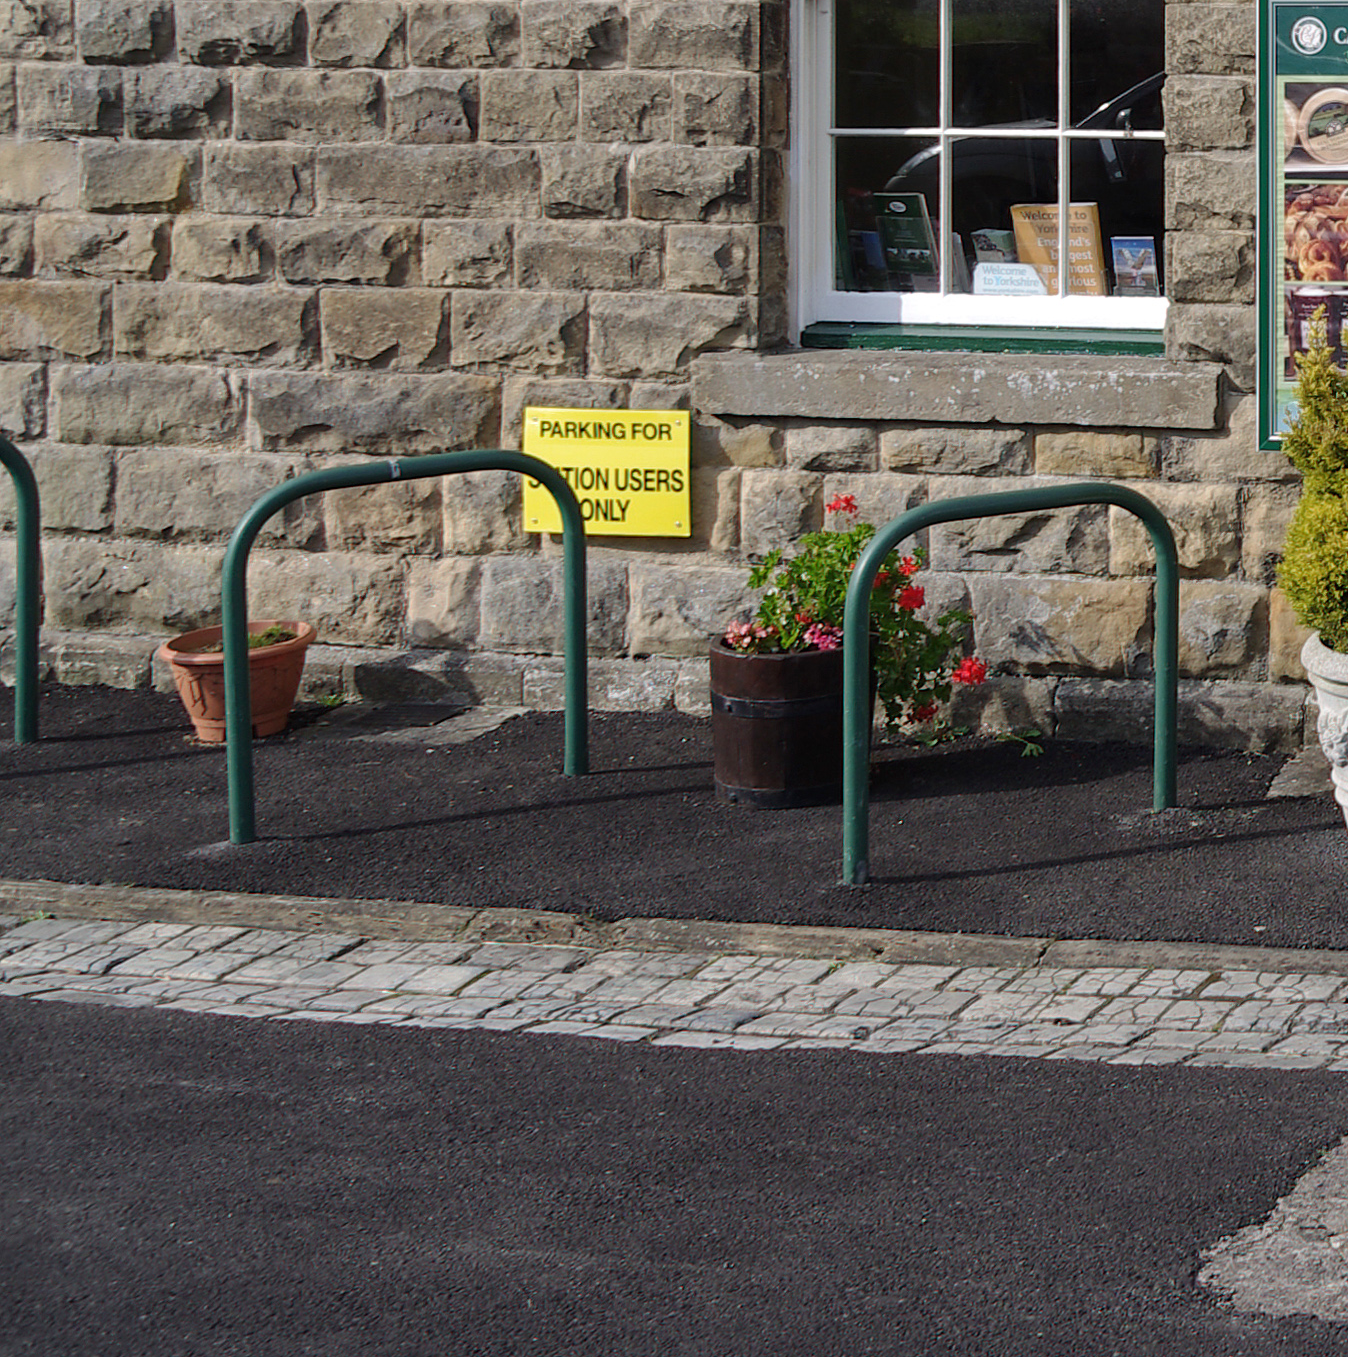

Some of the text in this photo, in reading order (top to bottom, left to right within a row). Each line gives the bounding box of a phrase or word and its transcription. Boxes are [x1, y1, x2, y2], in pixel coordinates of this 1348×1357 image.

[1075, 212, 1087, 220] to
[983, 266, 1026, 275] Welcome
[984, 276, 1039, 286] to Yorkshire
[540, 421, 672, 440] PARKING FOR
[615, 468, 684, 492] USERS
[581, 498, 631, 522] ONLY
